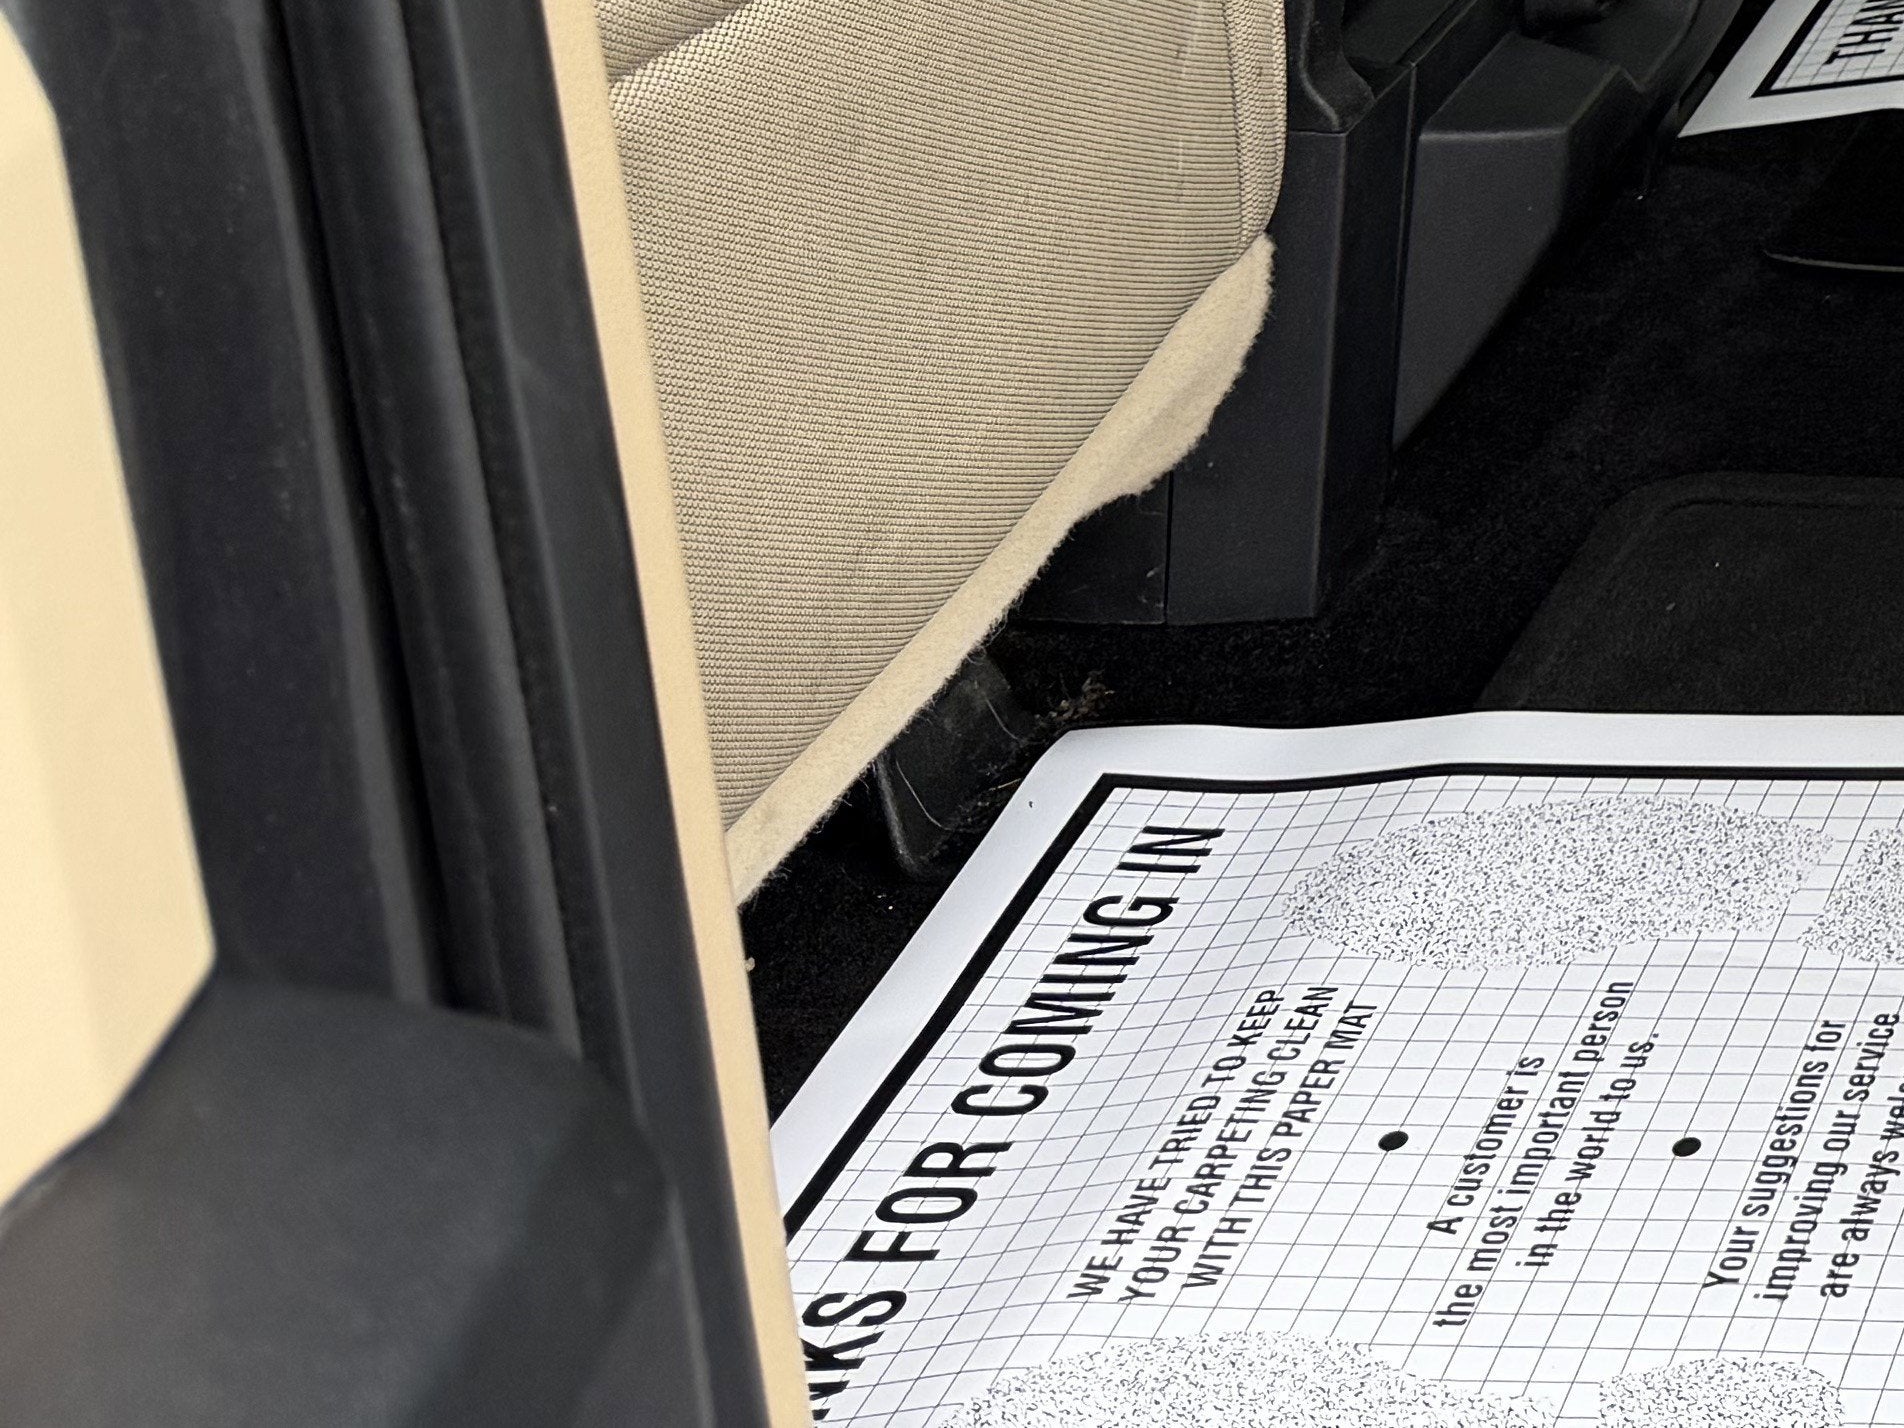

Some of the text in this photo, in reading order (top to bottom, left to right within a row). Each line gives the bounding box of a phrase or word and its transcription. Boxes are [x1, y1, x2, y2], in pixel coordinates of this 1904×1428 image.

[843, 1141, 1015, 1262] FOR
[951, 895, 1179, 1116] COMING
[1116, 825, 1226, 874] IN
[1066, 989, 1285, 1299] WE HAVE TRIED TO KEEP
[1117, 986, 1339, 1302] YOUR CARPETING CLEAN
[1181, 1000, 1378, 1289] WITH THIS PAPER MAT
[1426, 1056, 1546, 1235] A customer is
[1432, 981, 1634, 1328] the most important person
[1515, 1032, 1659, 1267] in the world to us.
[1701, 1019, 1847, 1289] Your suggestions for
[1753, 1012, 1901, 1301] improving our service
[1819, 1251, 1861, 1298] are
[1839, 1150, 1901, 1242] always
